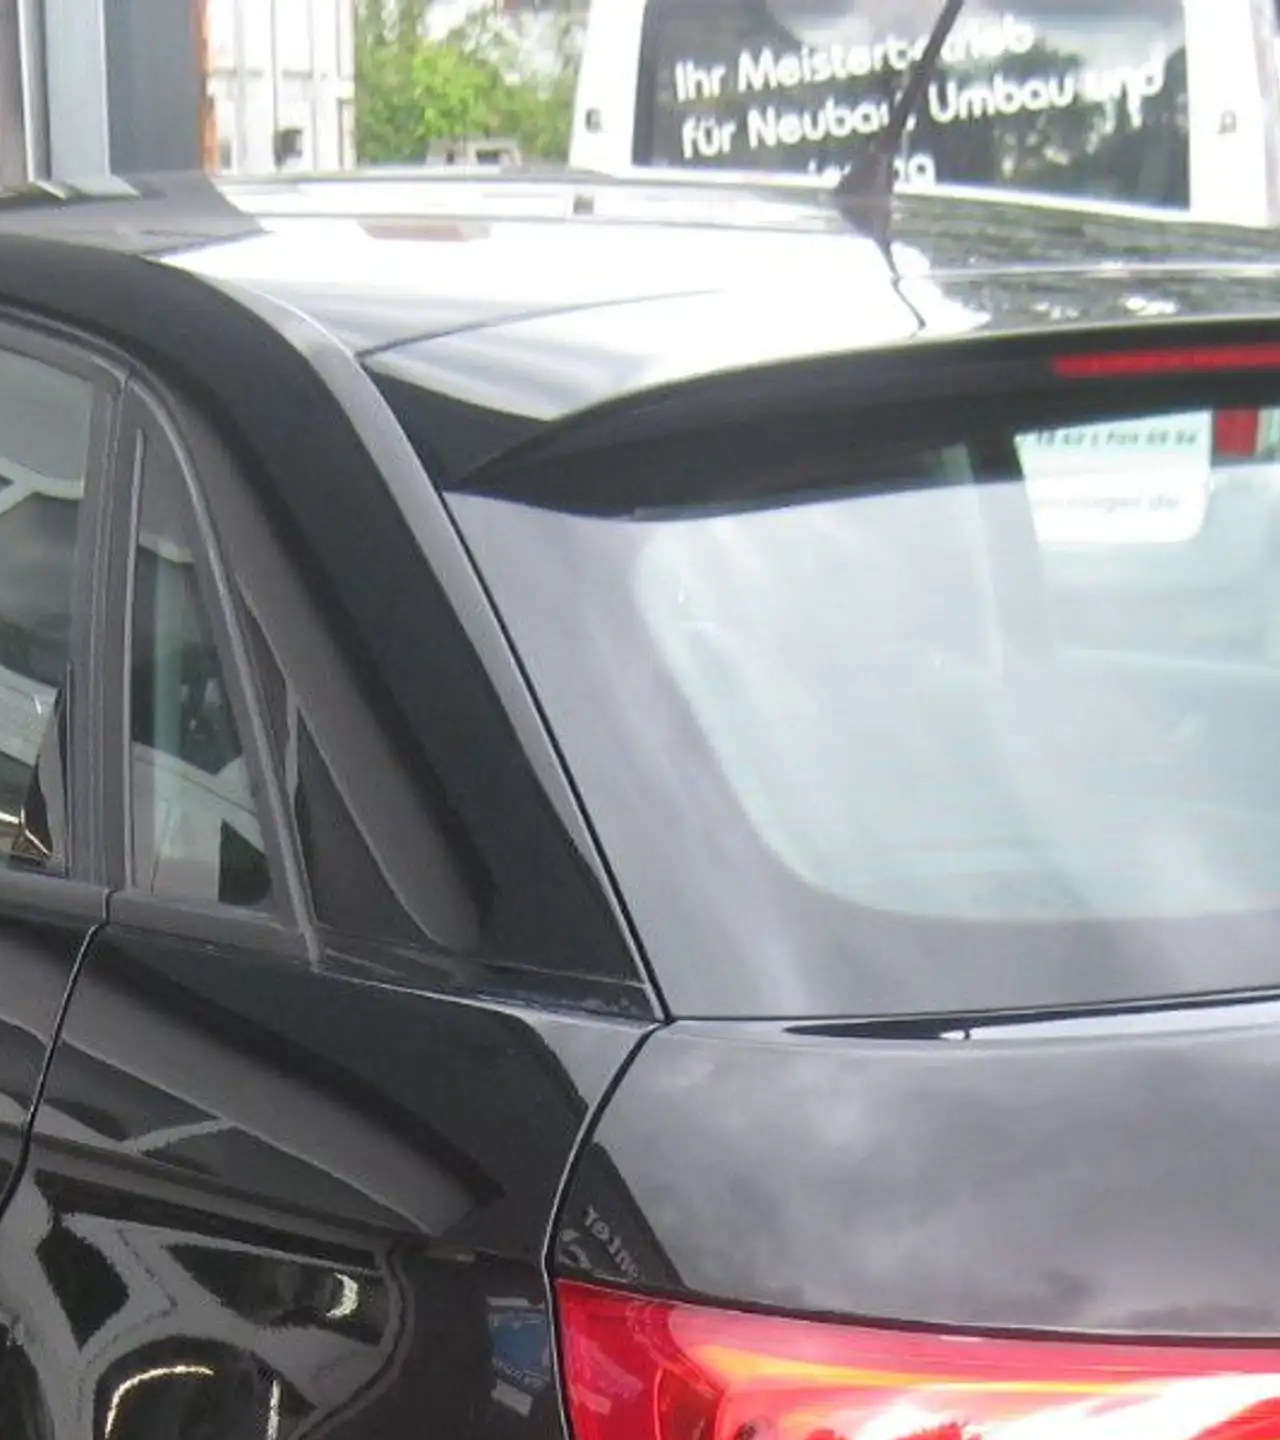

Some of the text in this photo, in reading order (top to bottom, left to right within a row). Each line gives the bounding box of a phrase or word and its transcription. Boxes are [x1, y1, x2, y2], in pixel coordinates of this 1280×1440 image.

[674, 60, 726, 103] Ihr
[681, 114, 737, 160] für
[927, 72, 1076, 123] Umbau
